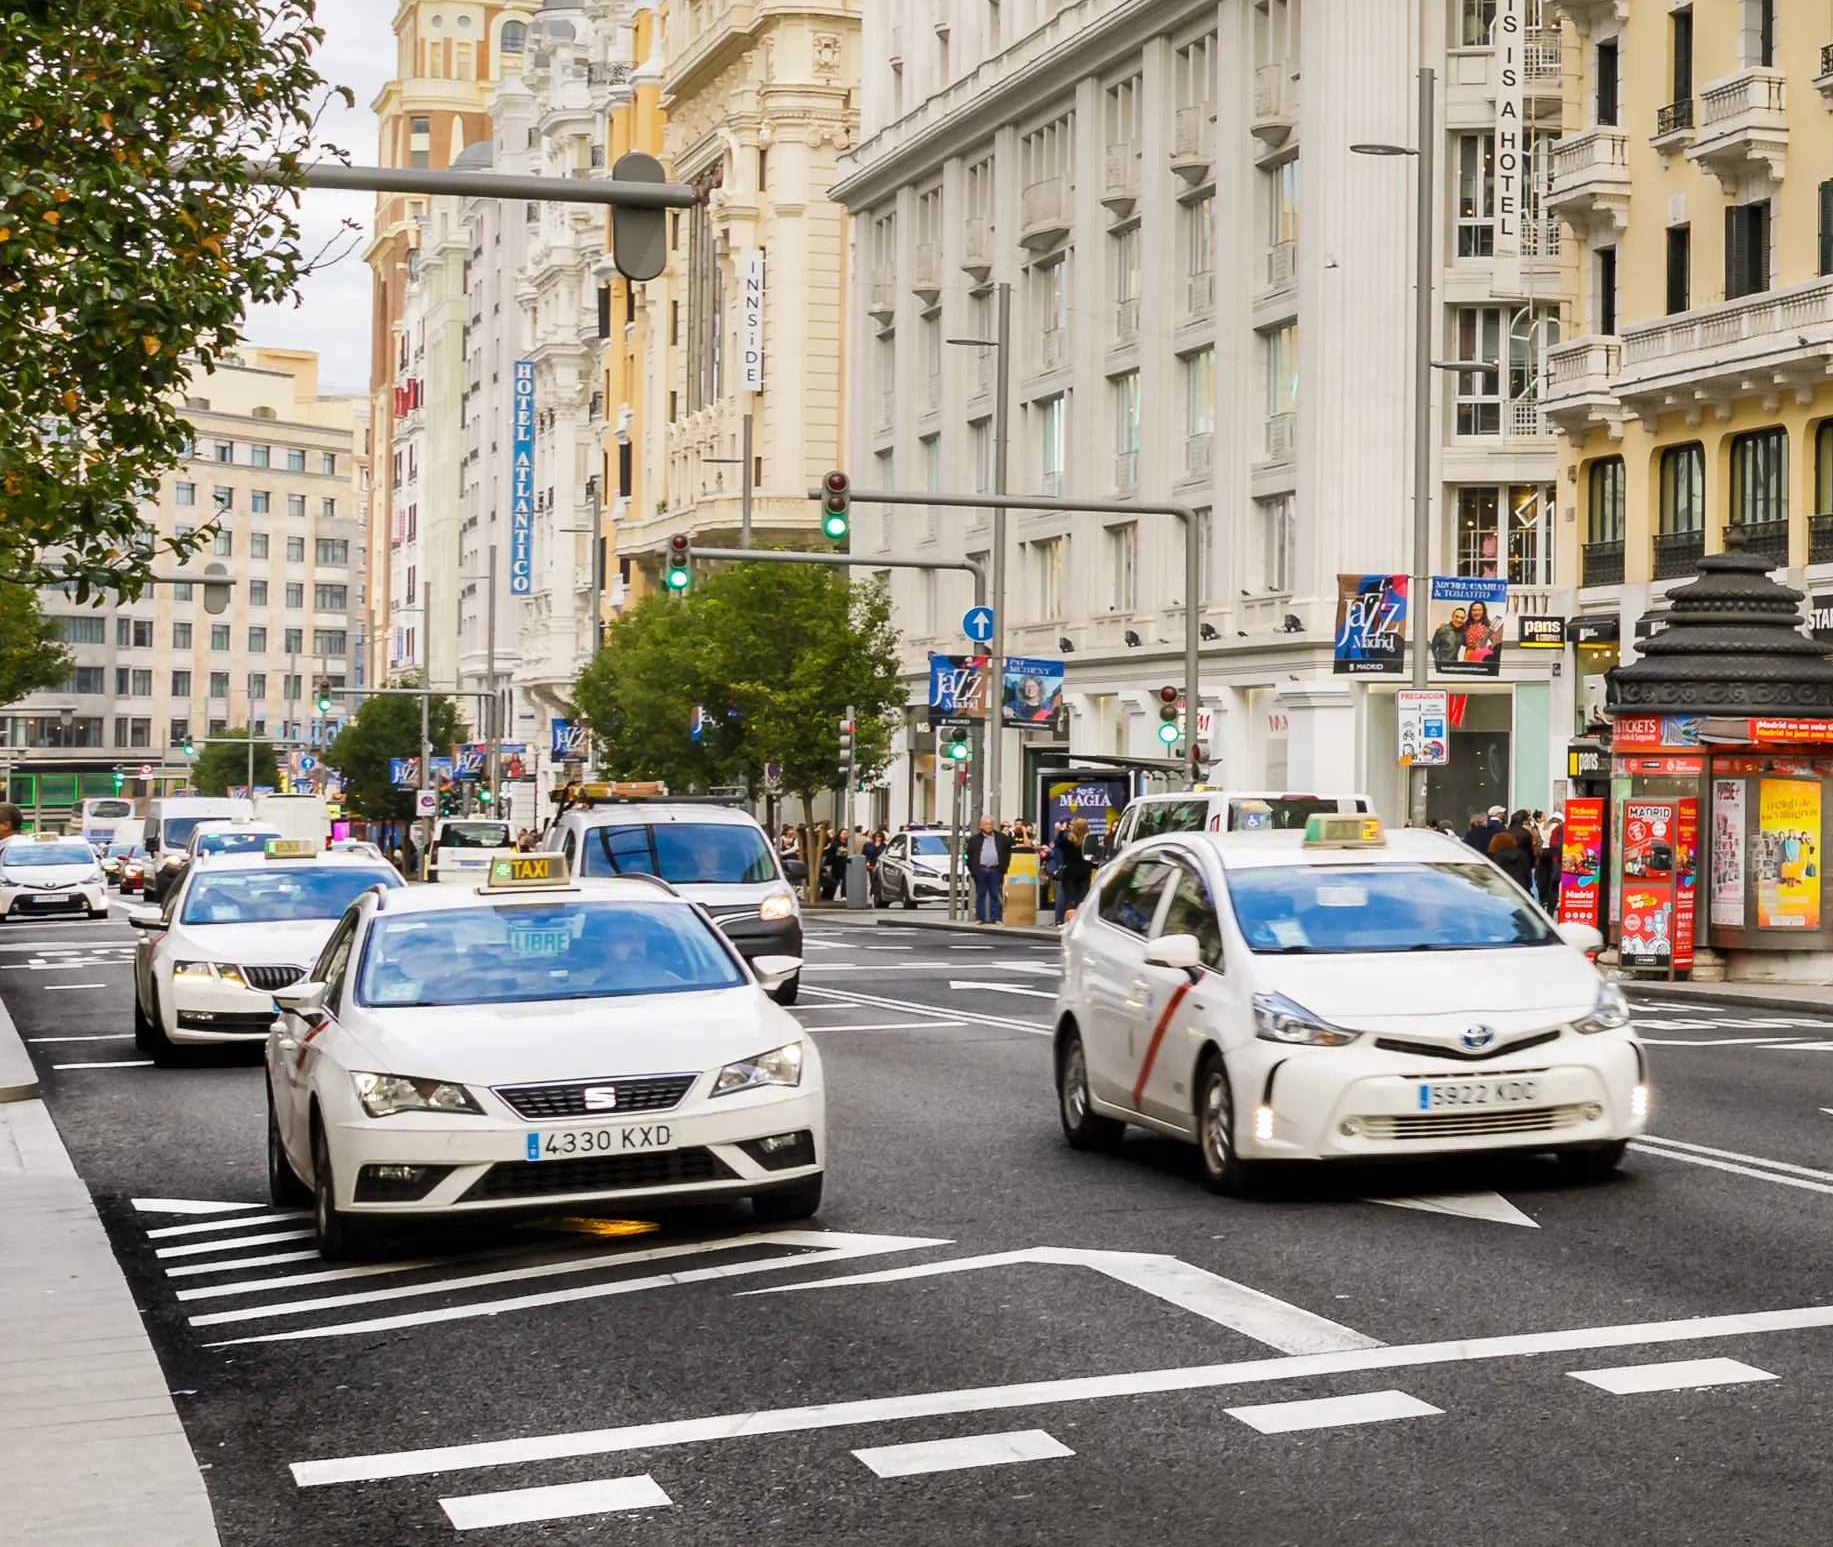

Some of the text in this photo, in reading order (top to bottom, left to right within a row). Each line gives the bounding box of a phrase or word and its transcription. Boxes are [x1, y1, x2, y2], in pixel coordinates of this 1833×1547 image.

[1502, 47, 1517, 87] IS
[1500, 101, 1517, 119] A
[1500, 132, 1517, 235] HOTEL
[512, 364, 532, 591] HOTEL ATLANTICO
[1435, 581, 1506, 591] MICHEL CAMILO
[1524, 620, 1561, 636] pans
[1352, 633, 1395, 651] Madrid
[1356, 663, 1384, 671] MADRID
[1621, 719, 1657, 734] TICKETS
[1577, 751, 1599, 777] pans
[1059, 794, 1113, 807] MAGIA
[1569, 806, 1598, 816] Tickets
[1628, 806, 1672, 819] MADRID
[1362, 820, 1379, 841] 2
[511, 858, 549, 879] TAXI
[1565, 889, 1594, 900] Madrid
[513, 931, 568, 953] LIBRE
[1432, 1084, 1489, 1105] 5922
[545, 1125, 671, 1154] 4330 KXD
